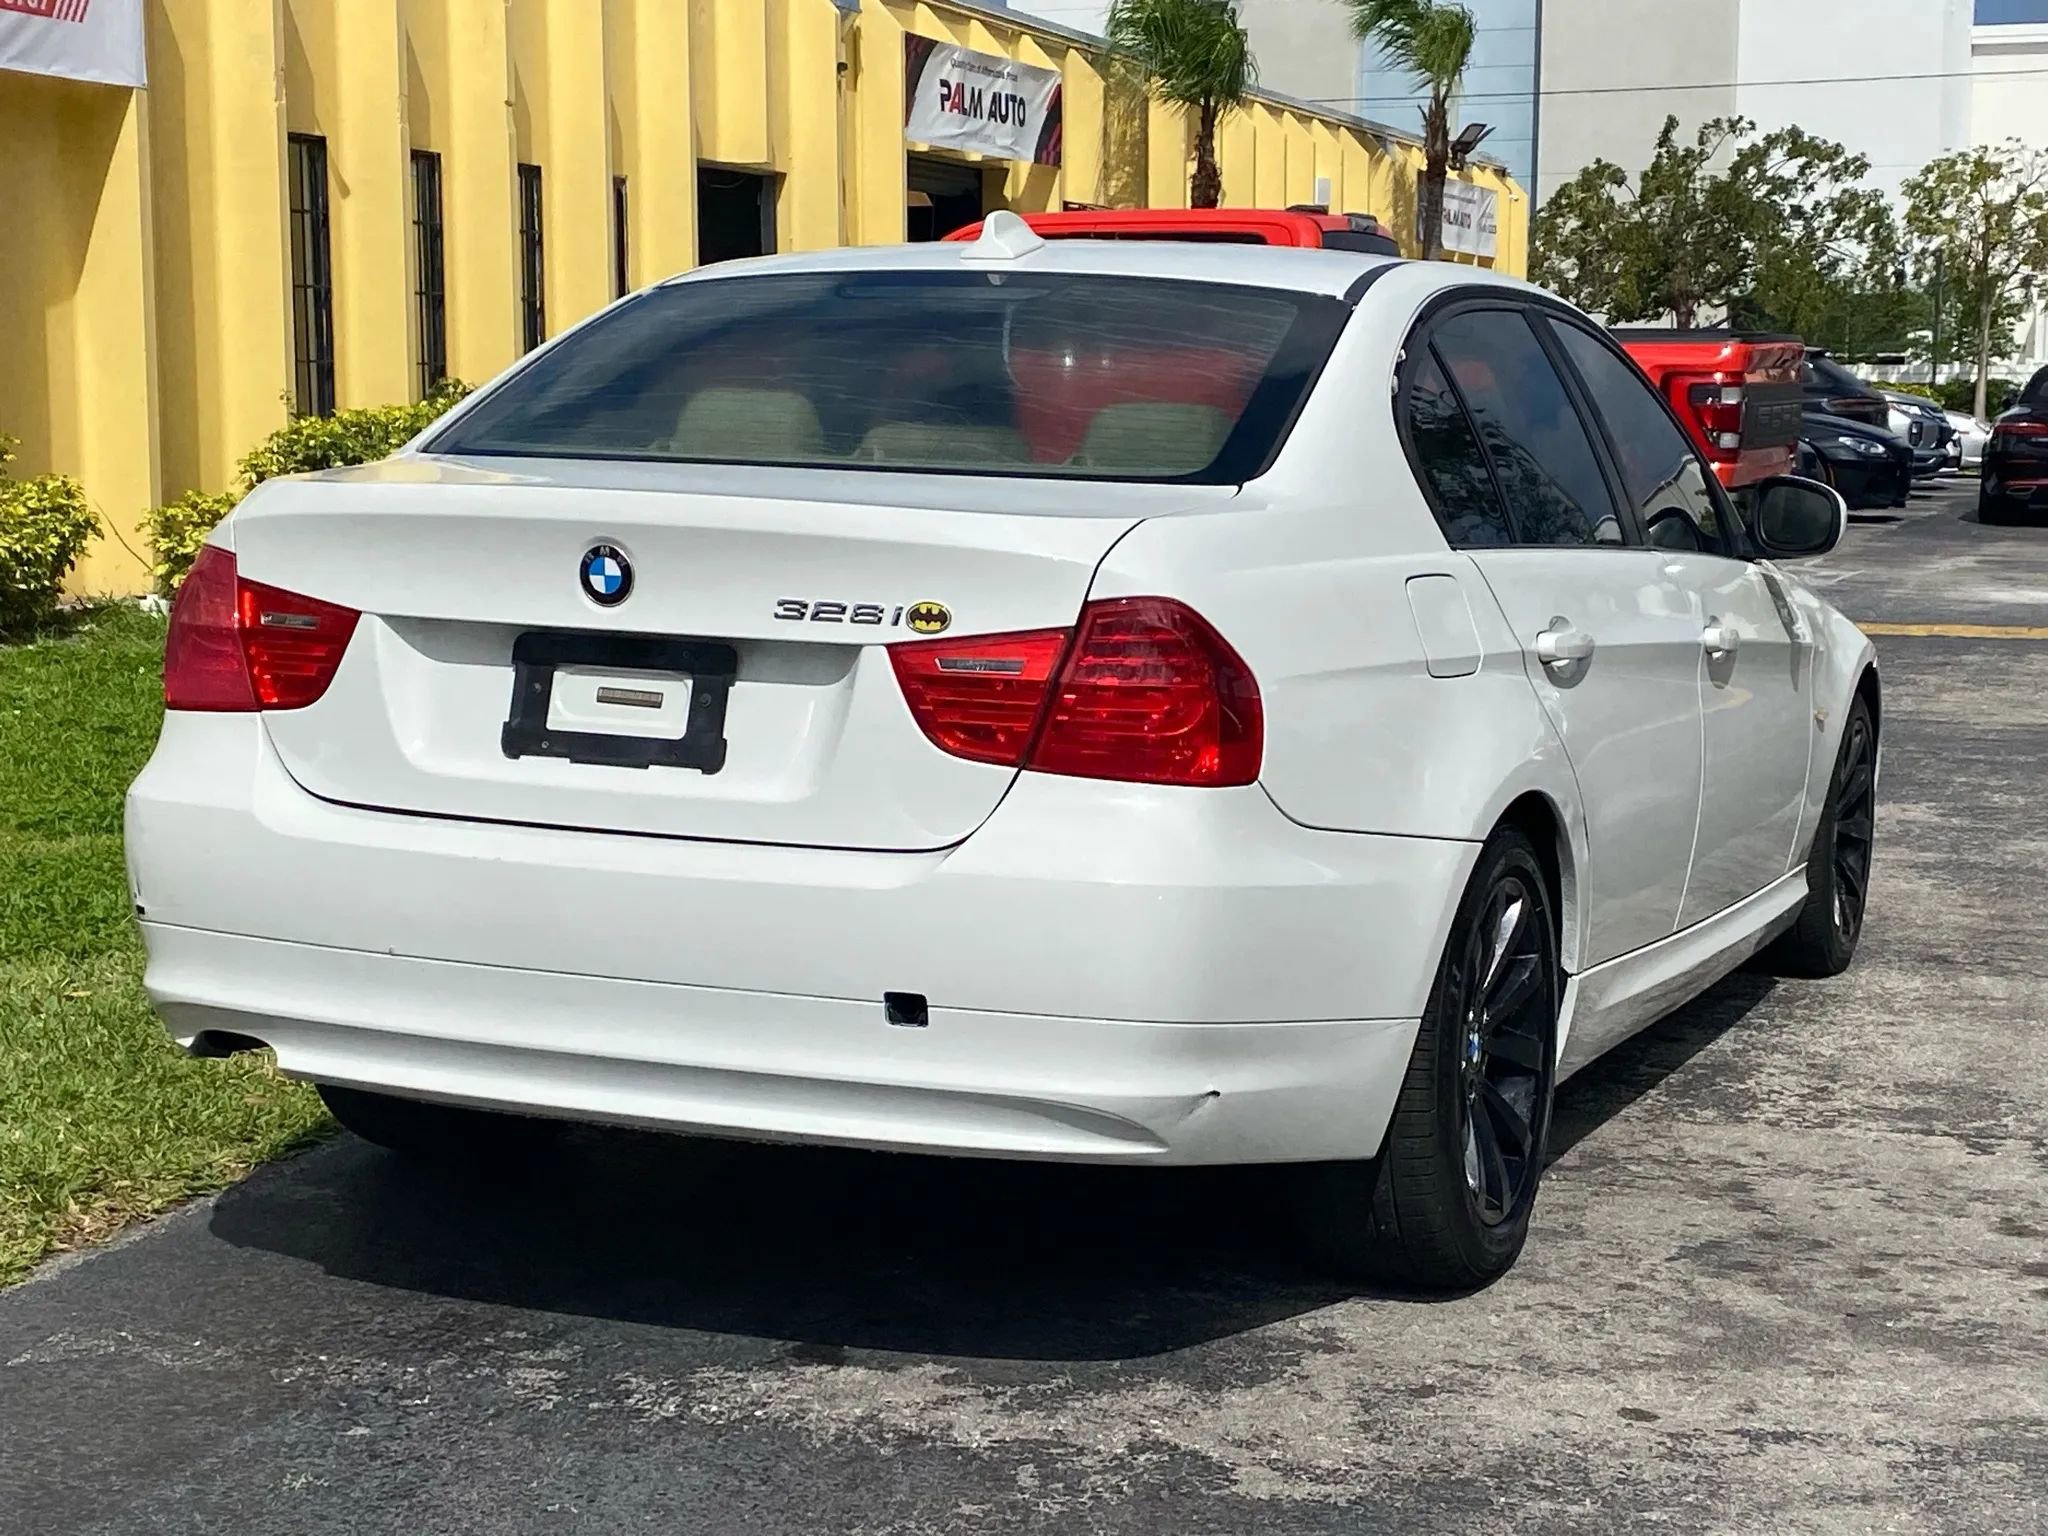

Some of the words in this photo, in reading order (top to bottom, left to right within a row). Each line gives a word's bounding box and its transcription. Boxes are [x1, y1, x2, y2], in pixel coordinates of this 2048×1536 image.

[939, 78, 983, 120] PALM
[987, 91, 1026, 128] AUTO
[774, 599, 903, 626] 328i
